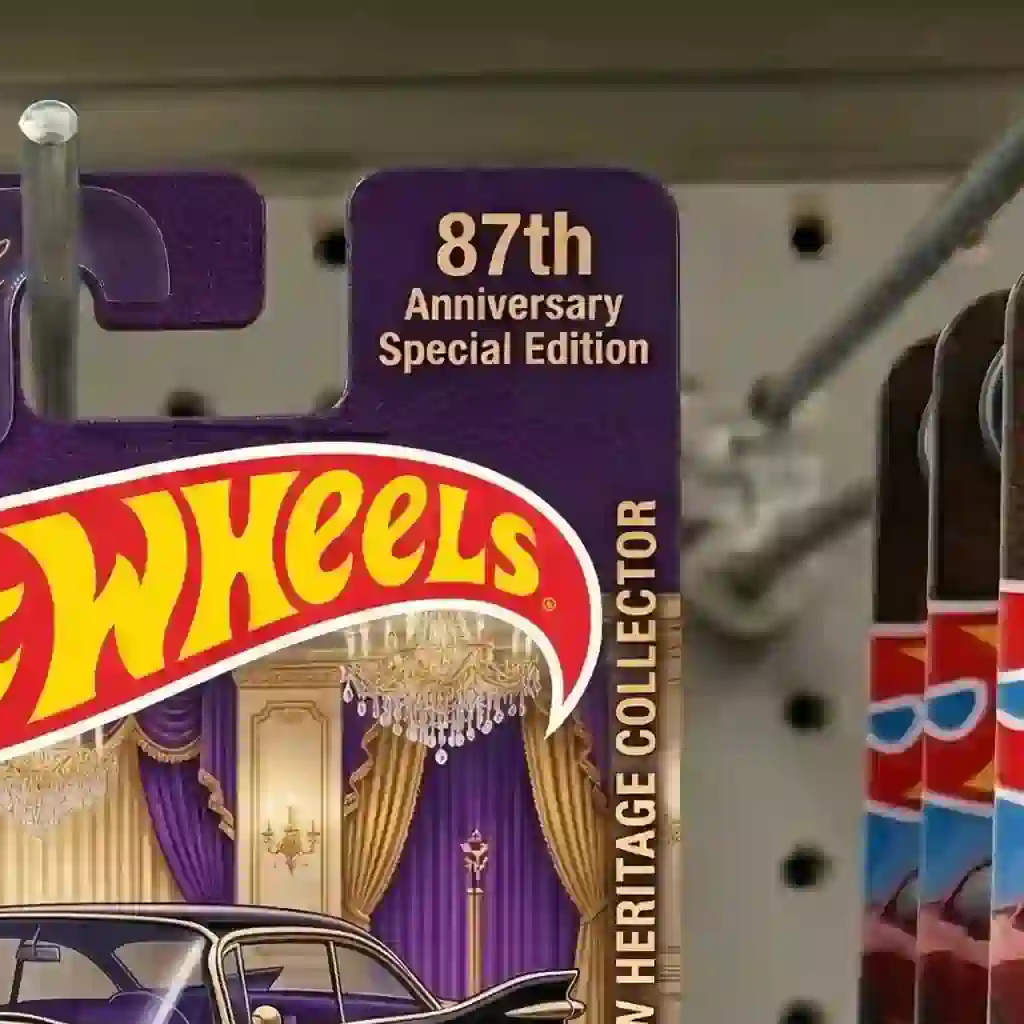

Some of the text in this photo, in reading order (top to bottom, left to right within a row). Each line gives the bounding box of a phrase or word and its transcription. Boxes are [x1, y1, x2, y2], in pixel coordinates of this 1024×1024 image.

[436, 211, 592, 277] 87th
[404, 287, 624, 327] Anniversary
[378, 331, 649, 374] Special Edition
[616, 499, 657, 756] COLLECTOR
[616, 771, 656, 985] HERITAGE
